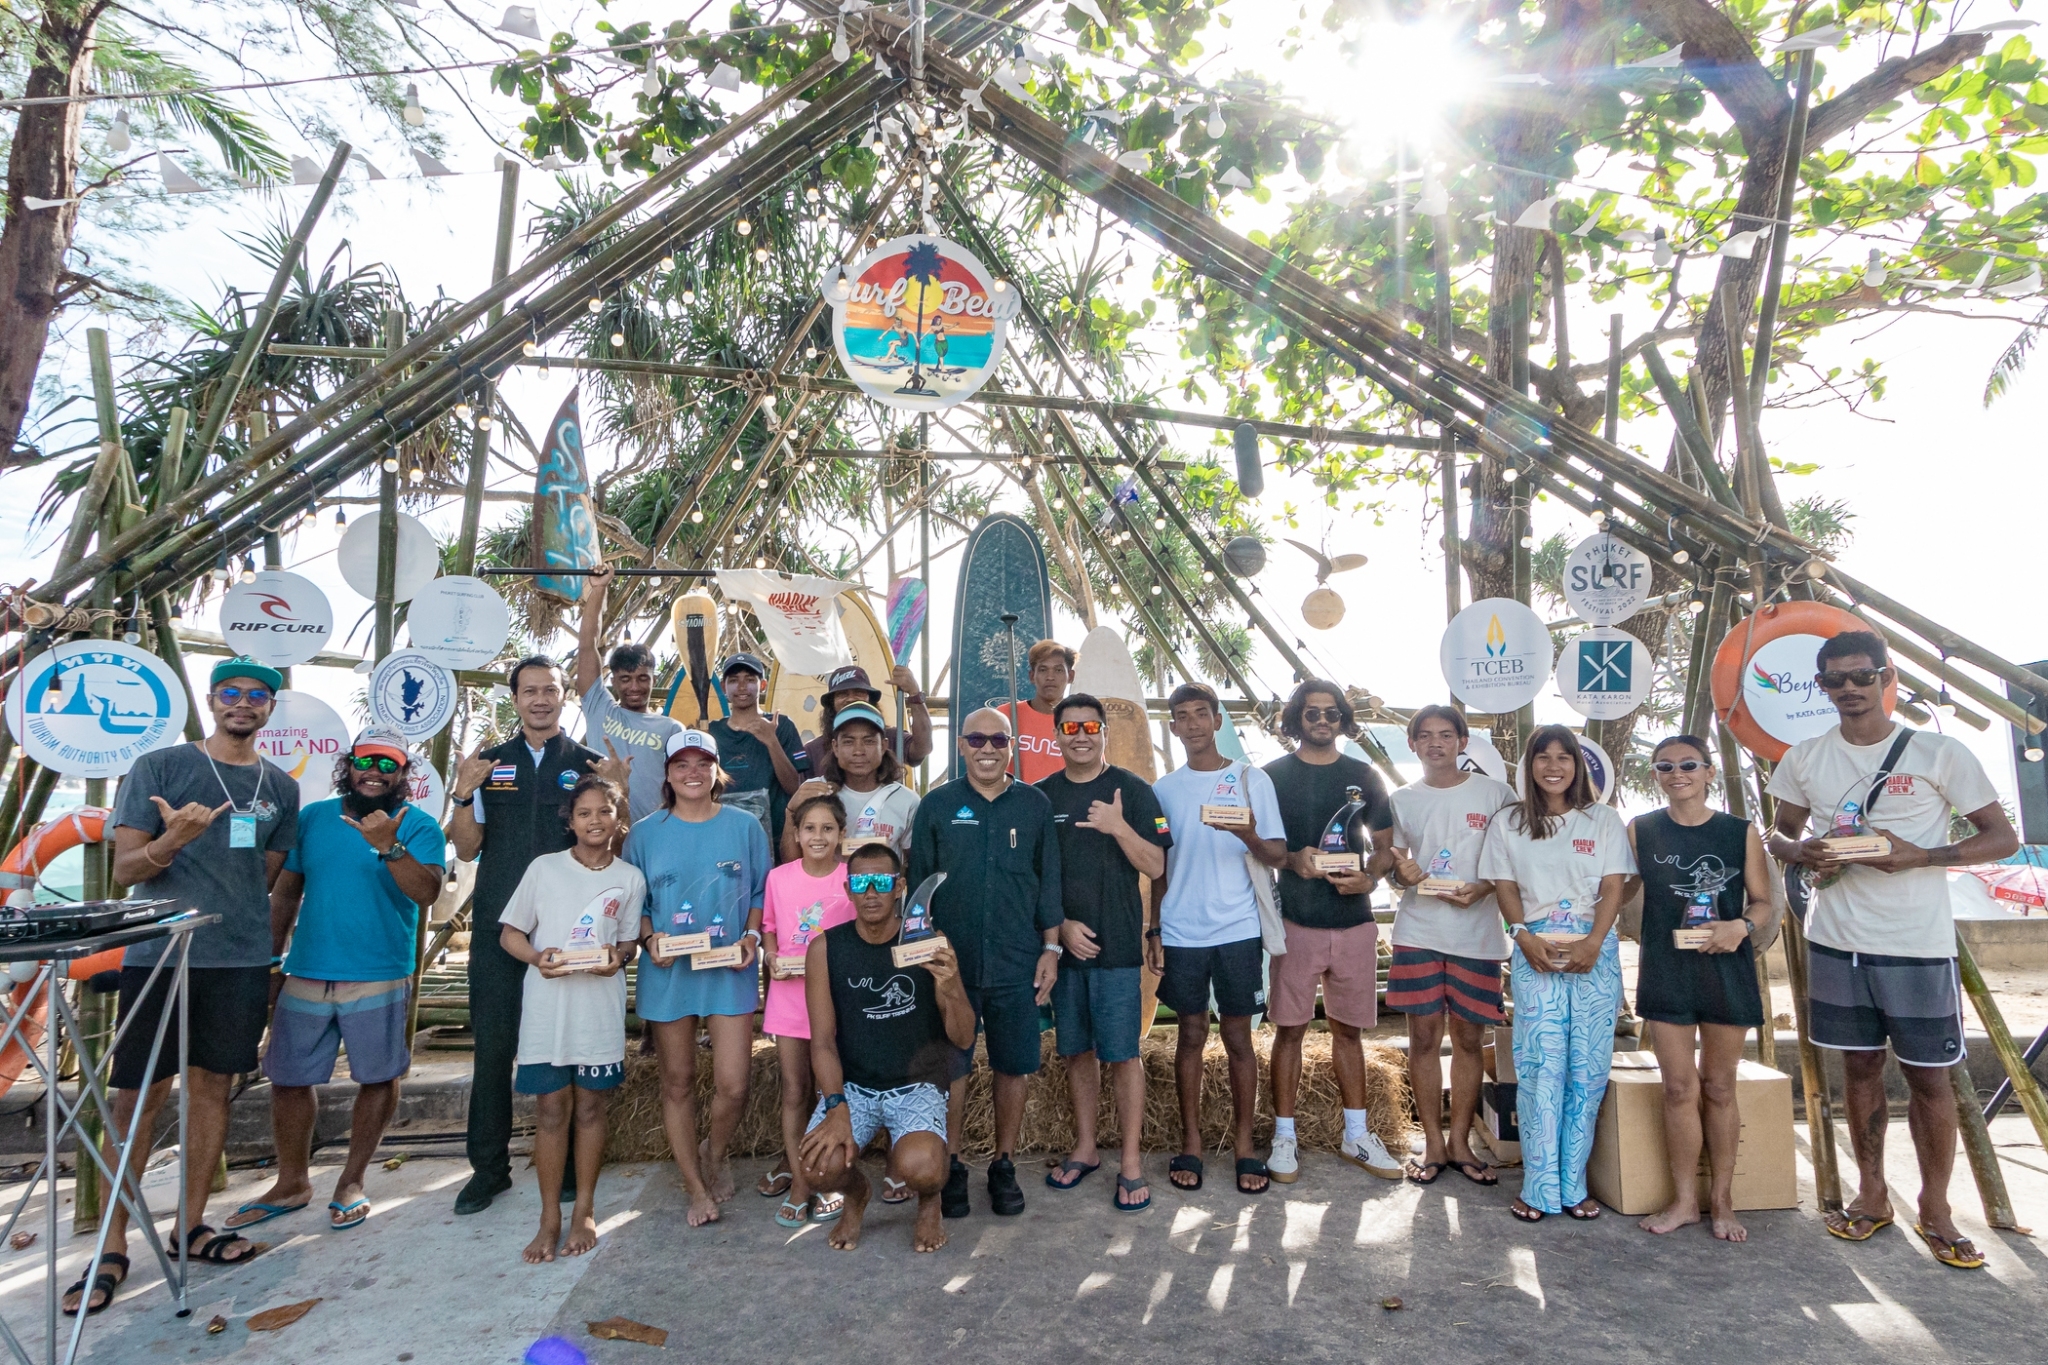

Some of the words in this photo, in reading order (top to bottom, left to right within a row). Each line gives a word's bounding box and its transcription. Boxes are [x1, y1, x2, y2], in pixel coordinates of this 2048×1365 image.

[938, 280, 1021, 319] Beat
[1585, 543, 1632, 561] PHUKET
[1571, 562, 1645, 592] SURF
[1580, 597, 1615, 615] FESTIVAL
[1617, 595, 1636, 612] 2022
[229, 622, 269, 632] RIP
[270, 623, 327, 634] CURL
[1470, 658, 1524, 676] TCEB
[1462, 677, 1493, 685] THAILAND
[1493, 674, 1535, 682] CONVENTION
[1471, 682, 1506, 690] EXHIBITION
[1768, 671, 1820, 703] Beyo
[378, 703, 394, 725] PHUKET
[394, 723, 419, 732] TOURIST
[419, 694, 446, 730] ASSOCIATION
[1795, 710, 1815, 719] KATA
[1816, 707, 1839, 716] GROU
[256, 726, 309, 738] amazing
[602, 715, 648, 746] SUNOVA
[27, 717, 61, 752] TOURISM
[58, 744, 118, 764] AUTHORITY
[120, 745, 134, 760] OF
[133, 718, 168, 753] THAILAND
[256, 738, 340, 757] AILAND
[1887, 785, 1909, 794] CREW
[1466, 812, 1487, 824] KHAOLAK
[1469, 820, 1484, 829] CREW
[1572, 839, 1596, 848] KHAOLAK
[122, 911, 147, 920] Pioneer
[875, 1012, 892, 1020] SURF
[891, 1004, 917, 1018] TRAINING
[578, 1061, 621, 1078] ROXY
